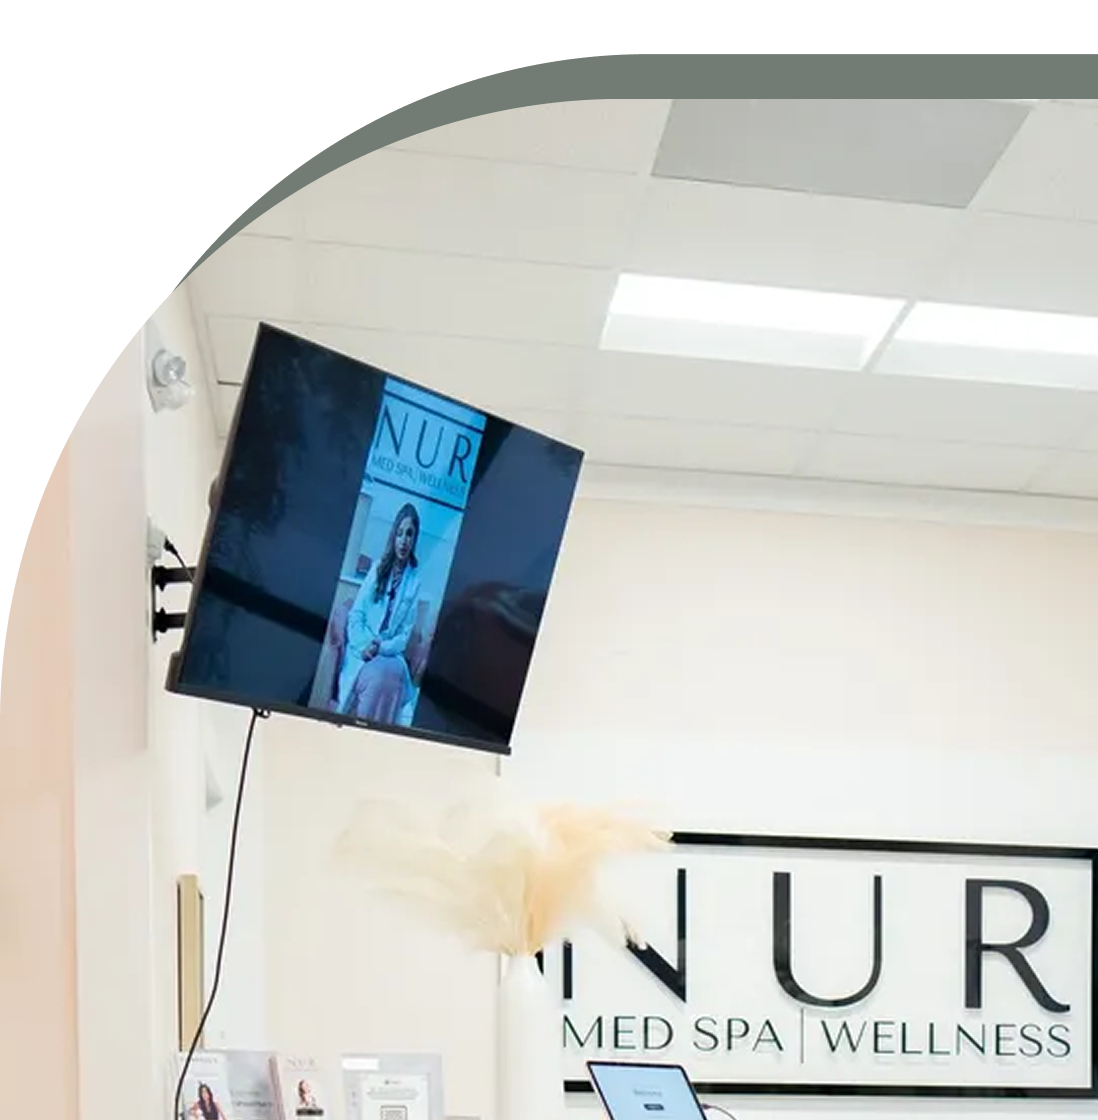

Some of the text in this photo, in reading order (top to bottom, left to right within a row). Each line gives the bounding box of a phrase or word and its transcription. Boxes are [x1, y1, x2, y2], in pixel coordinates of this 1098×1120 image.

[372, 455, 395, 471] MED
[375, 404, 472, 484] NUR
[562, 867, 1071, 1014] NUR
[562, 1014, 1071, 1058] MED SPA WELLNESS
